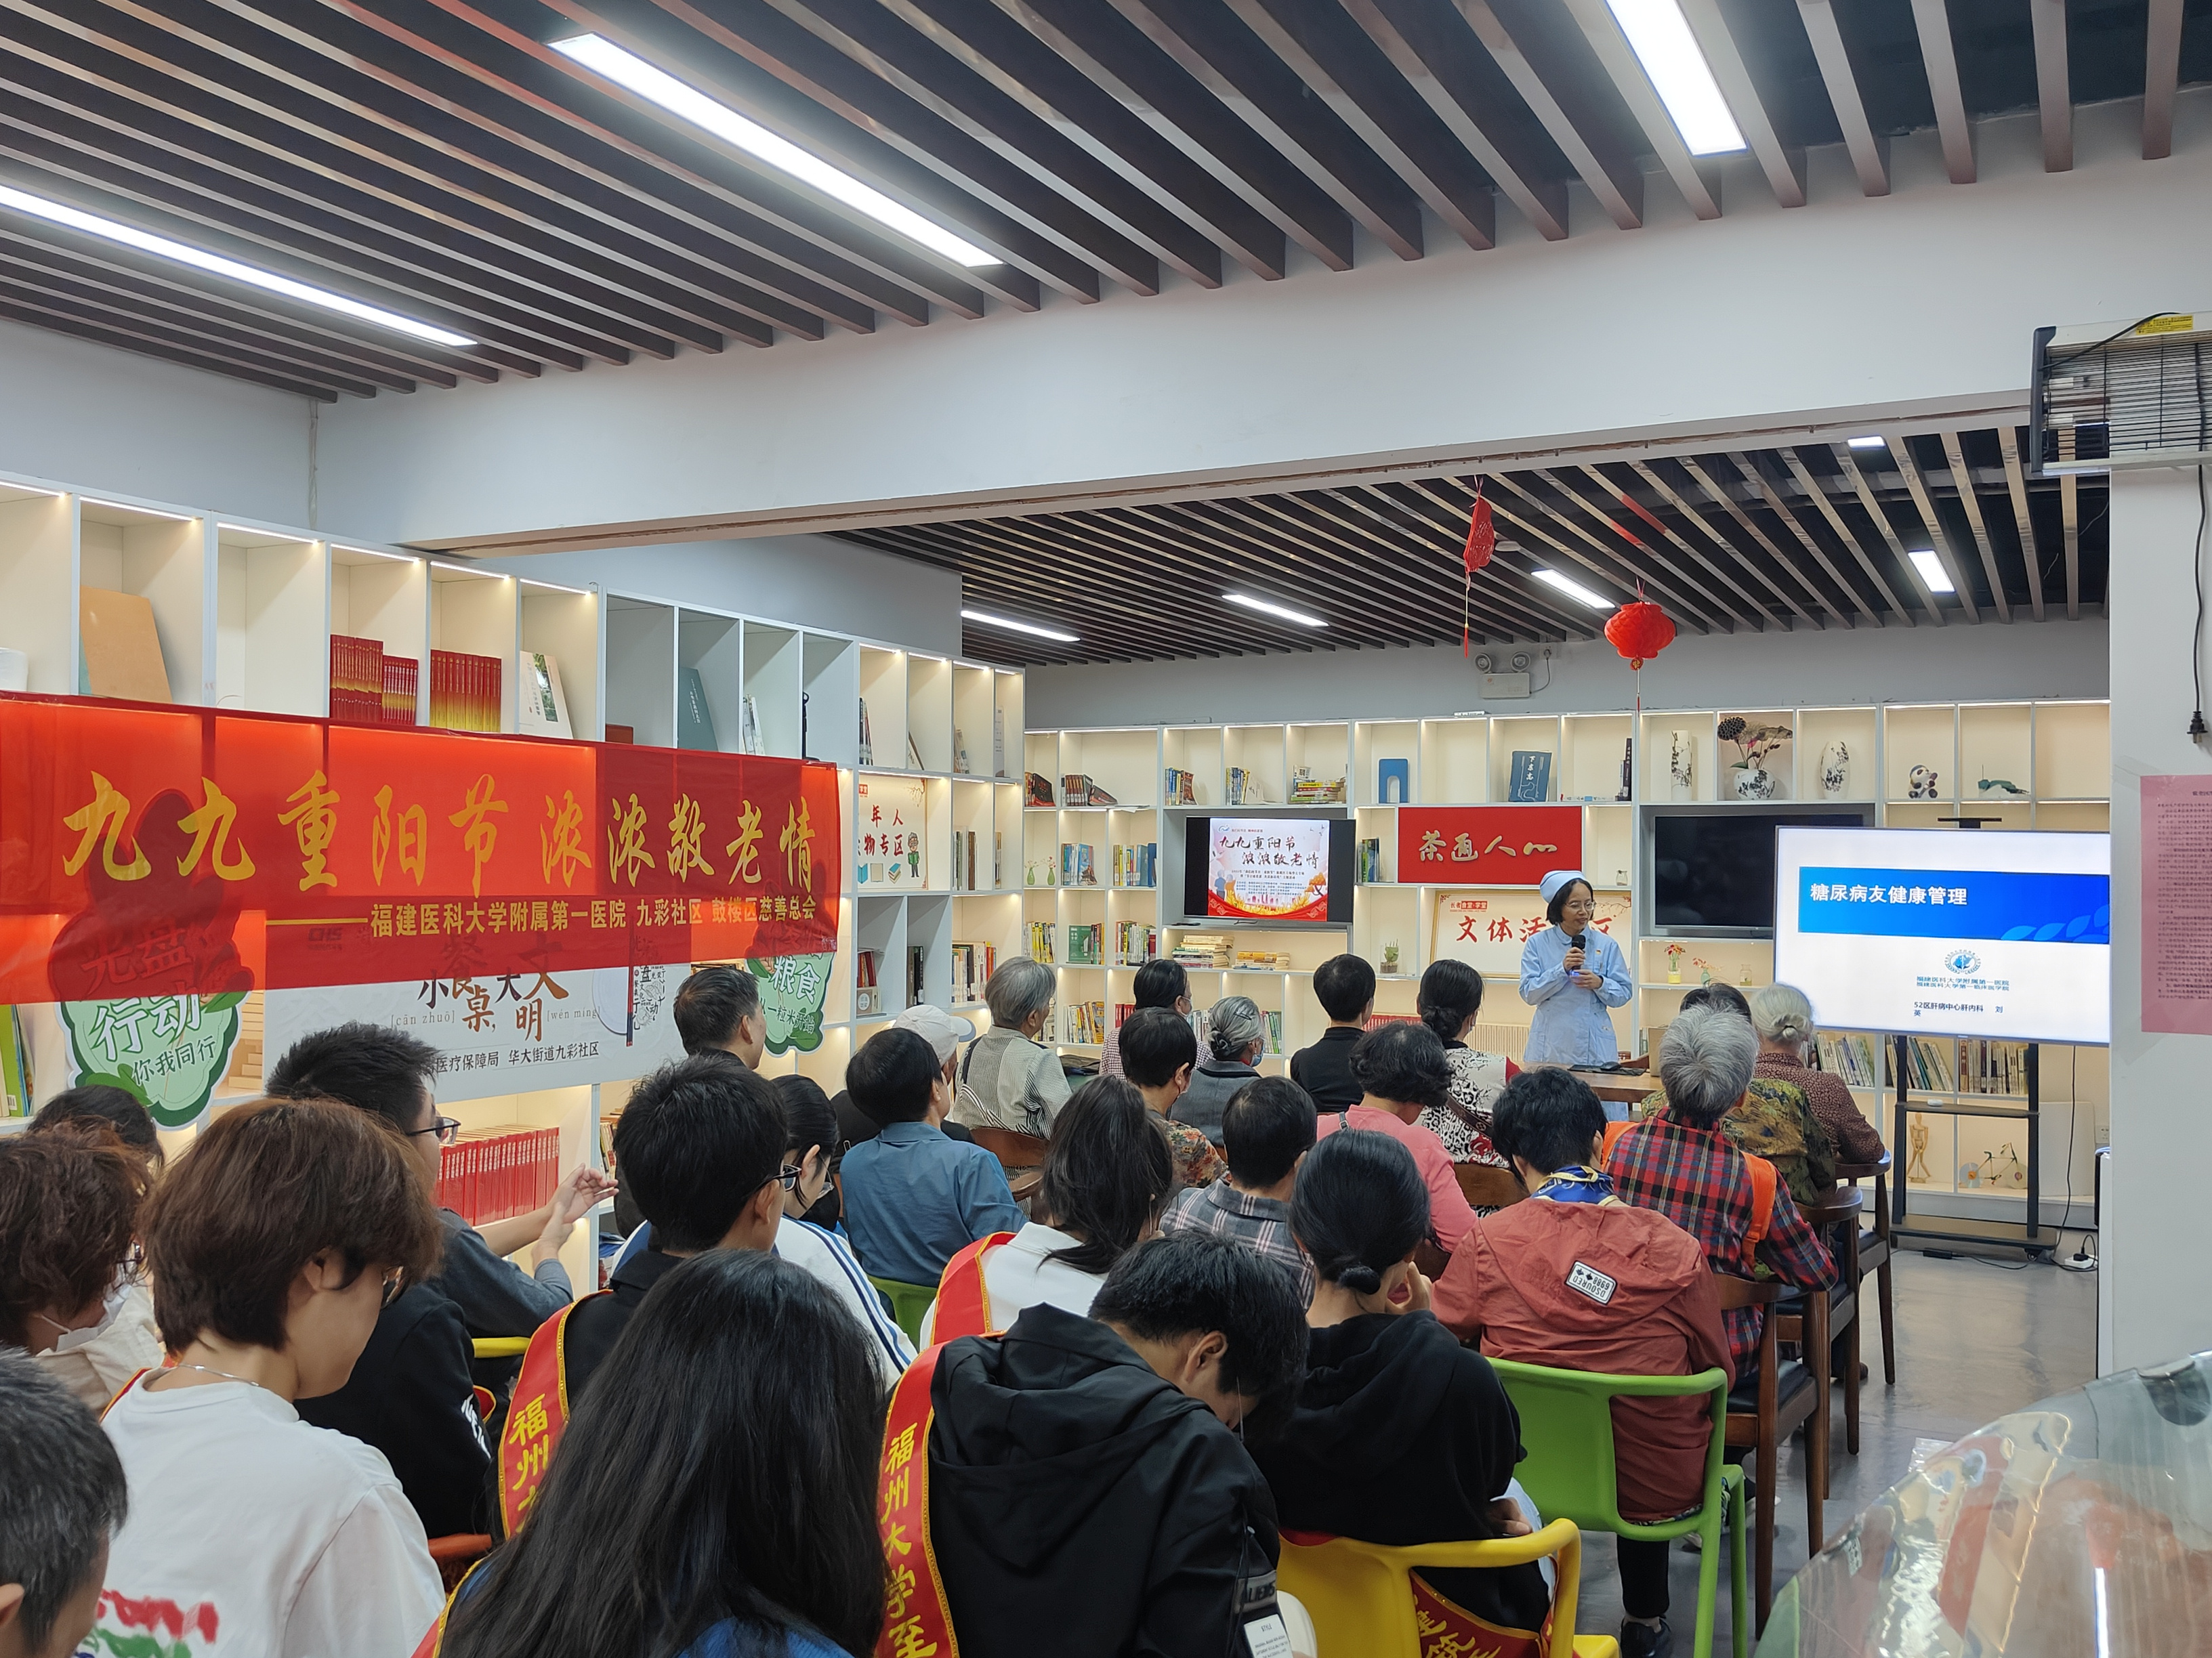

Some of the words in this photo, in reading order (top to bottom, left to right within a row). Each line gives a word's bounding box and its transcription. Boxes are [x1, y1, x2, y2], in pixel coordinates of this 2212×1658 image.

[858, 832, 904, 857] 物专区
[1219, 835, 1296, 852] 九九重阳节
[1241, 851, 1319, 870] 浓浓敬老情
[1810, 883, 1968, 906] 糖尿病友健康管理
[371, 899, 626, 937] 福建医科大学附属第一医院
[636, 897, 703, 928] 九彩社区
[711, 894, 816, 924] 鼓楼区慈善总会
[770, 956, 820, 1004] 粮食
[1913, 1009, 1921, 1017] 英
[1914, 1001, 1984, 1013] 52区肝病中心肝内科
[1995, 1005, 2003, 1014] 刘
[131, 1035, 216, 1086] 你我同行
[428, 1051, 499, 1074] 医疗保障局
[509, 1041, 600, 1066] 华大街道九彩社区
[1572, 1275, 1606, 1298] DSOURED
[1592, 1277, 1610, 1290] 6988
[880, 1422, 938, 1658] 福州大学至
